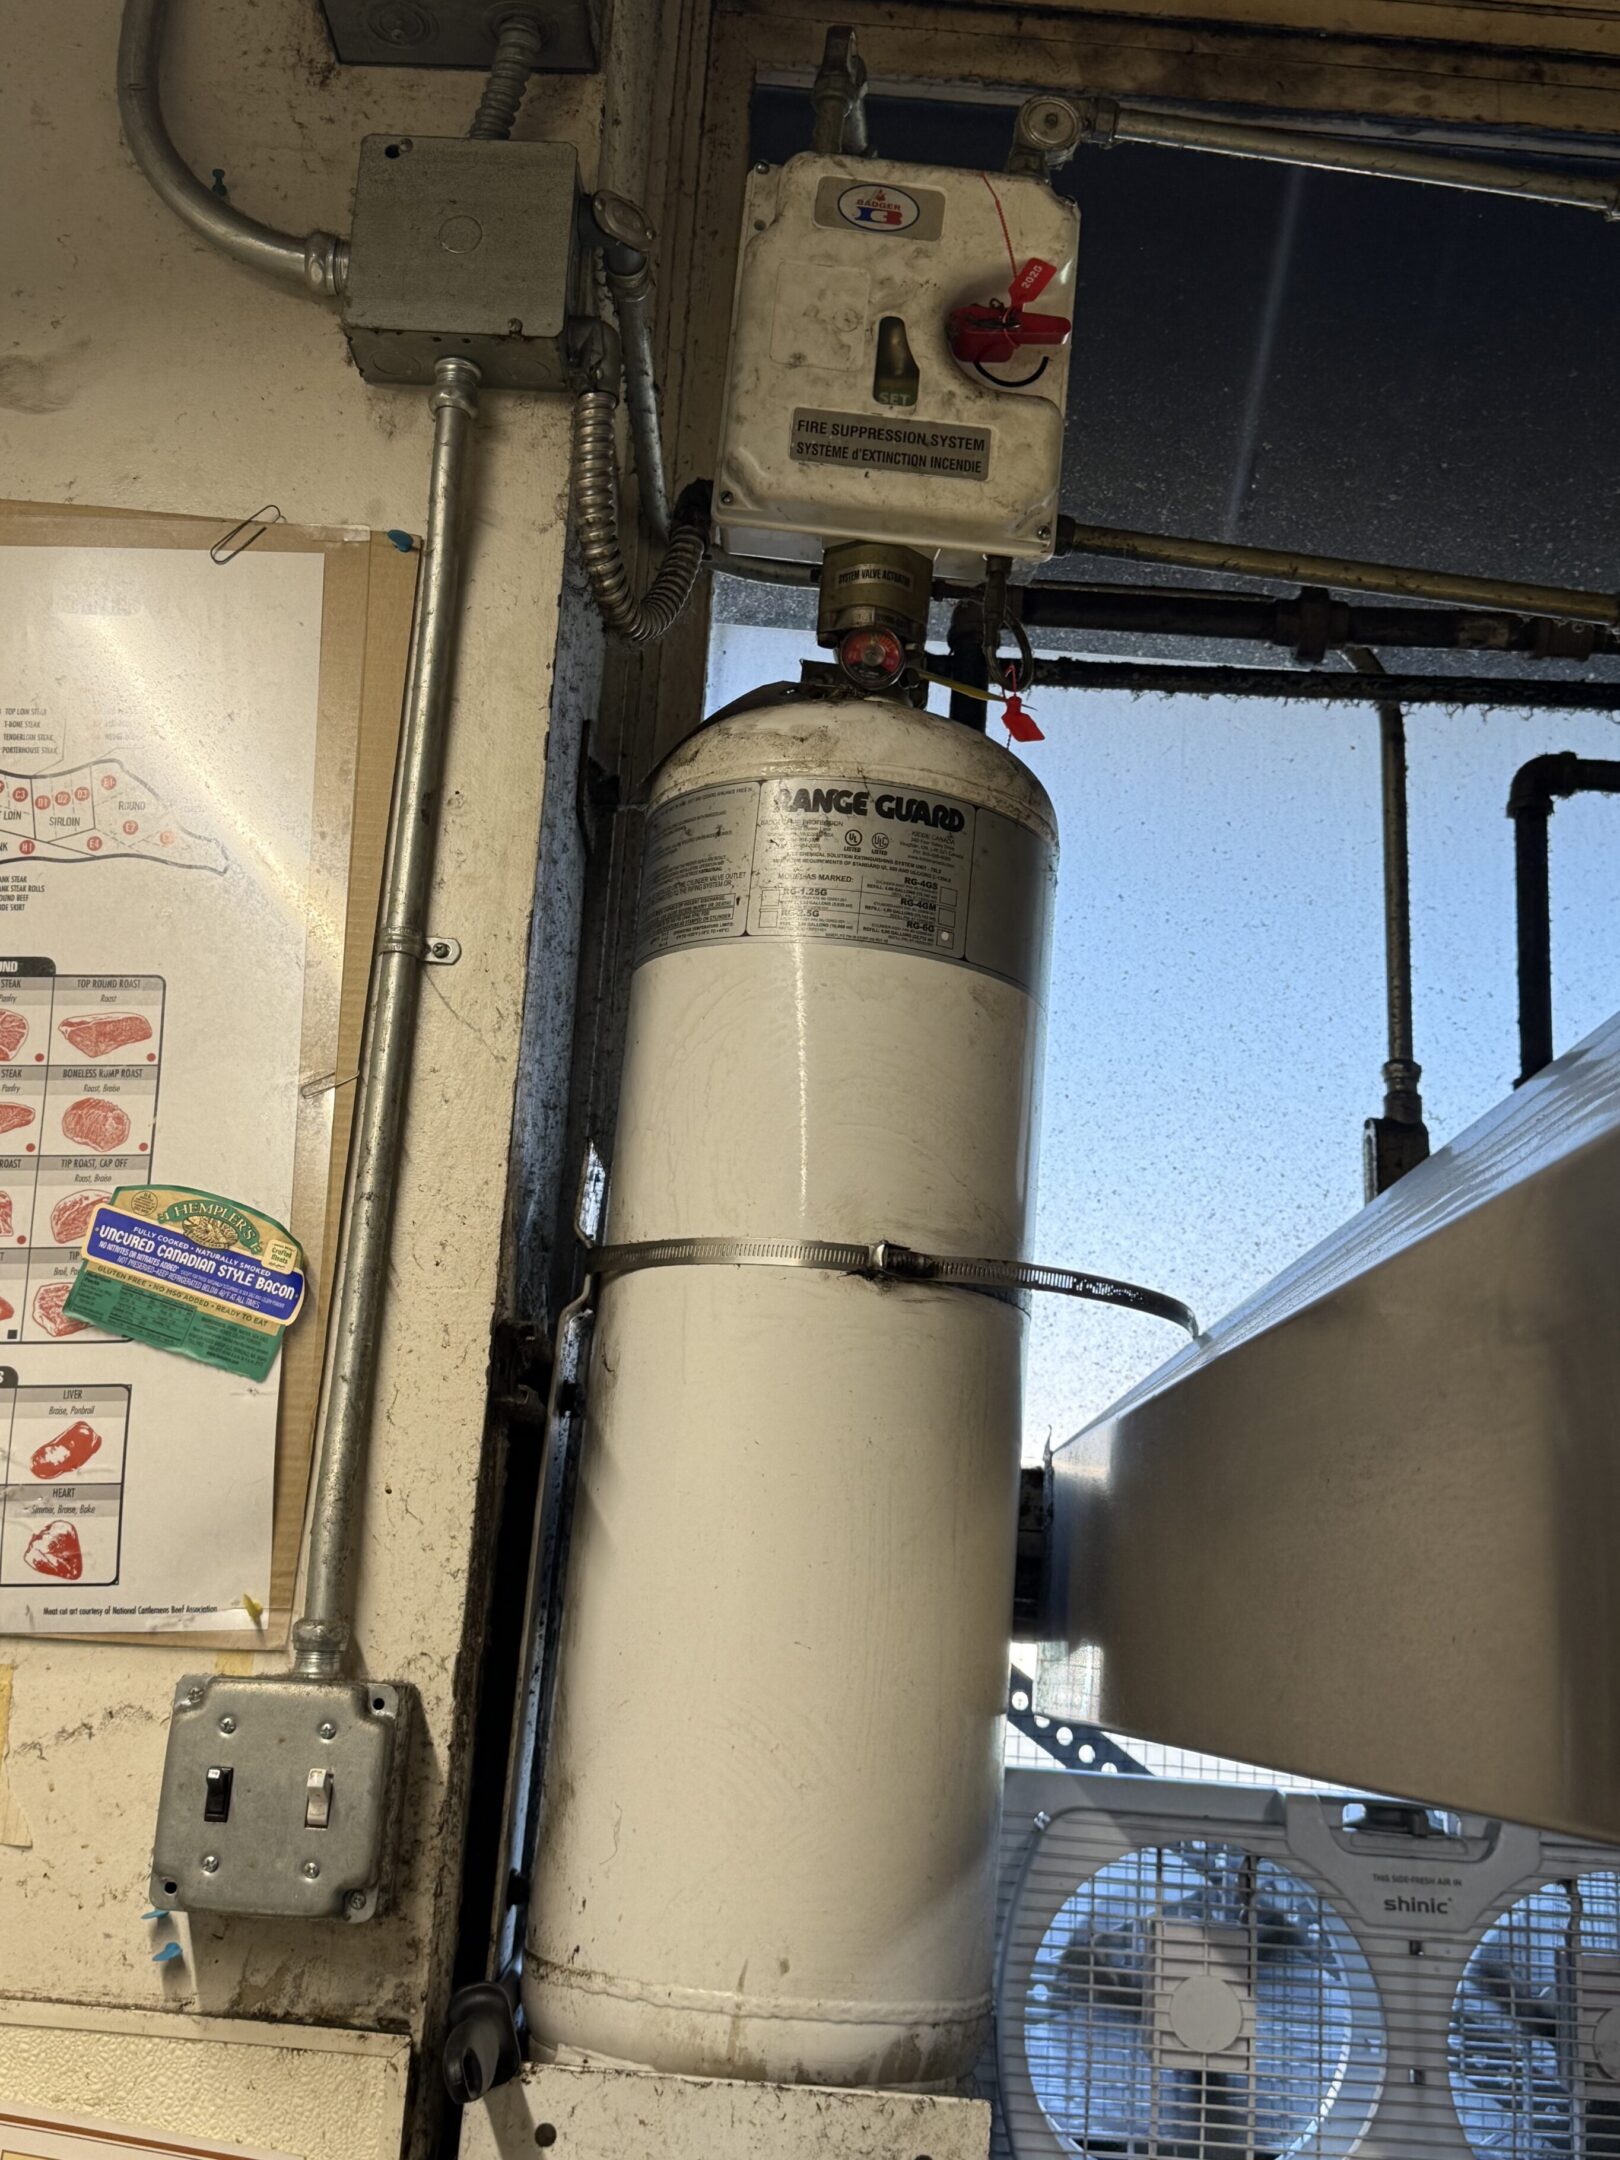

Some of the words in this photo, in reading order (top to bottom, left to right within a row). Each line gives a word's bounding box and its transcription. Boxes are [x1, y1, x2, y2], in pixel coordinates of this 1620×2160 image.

[856, 199, 901, 211] BADGER
[879, 392, 910, 406] SET
[797, 419, 828, 434] FIRE
[831, 423, 926, 445] SUPPRESSION
[930, 434, 985, 451] SYSTEM
[852, 447, 926, 468] d'EXTINCTION
[930, 456, 982, 473] INCENDIE
[861, 568, 881, 579] VALVE
[15, 789, 26, 798] C3
[118, 800, 146, 811] ROUND
[3, 810, 22, 821] LOIN
[874, 794, 965, 833] GUARD
[49, 816, 81, 827] SIRLOIN
[871, 848, 888, 856] LISTED
[11, 875, 28, 883] STEAK
[724, 871, 747, 881] OUTLET
[818, 873, 854, 883] MARKED:
[10, 884, 27, 892] STEAK
[28, 884, 46, 893] ROLLS
[904, 877, 939, 890] RG-4GS
[783, 887, 828, 896] RG-1.25G
[16, 894, 29, 902] BEEF
[900, 897, 937, 912] RG-4GM
[906, 920, 935, 933] RG-6G
[1, 979, 22, 989] STEAK
[77, 979, 91, 988] TOP
[92, 979, 118, 989] ROUND
[119, 979, 141, 989] ROAST
[1, 1068, 22, 1078] STEAK
[62, 1068, 97, 1079] BONELESS
[99, 1068, 120, 1078] RUMP
[121, 1068, 143, 1078] ROAST
[61, 1158, 73, 1169] TIP
[73, 1158, 97, 1170] ROAST,
[99, 1158, 113, 1168] CAP
[114, 1158, 129, 1168] OFF
[174, 1201, 257, 1240] HEMPLER'S
[68, 1250, 80, 1261] TIP
[133, 1226, 157, 1239] FULLY
[157, 1234, 190, 1250] COOKED
[195, 1247, 239, 1266] NATURALLY
[240, 1262, 271, 1277] SMOKED
[99, 1224, 156, 1253] UNCURED
[156, 1244, 217, 1274] CANADIAN
[217, 1264, 255, 1287] STYLE
[255, 1276, 295, 1300] BACON
[97, 1265, 126, 1280] GLUTEN
[127, 1274, 147, 1287] FREE
[153, 1283, 165, 1293] NO
[166, 1287, 182, 1299] MSG
[182, 1293, 210, 1308] ADDED
[215, 1304, 241, 1317] READY
[242, 1312, 252, 1322] TO
[253, 1317, 269, 1327] EAT
[201, 1283, 219, 1295] BELOW
[245, 1298, 261, 1309] TIMES
[63, 1389, 83, 1400] LIVER
[48, 1406, 69, 1416] Braise,
[52, 1487, 76, 1498] HEART
[79, 1504, 96, 1514] Bake
[43, 1607, 57, 1615] Meat
[59, 1607, 68, 1615] cut
[69, 1607, 78, 1615] art
[79, 1607, 103, 1617] courtesy
[104, 1606, 112, 1615] of
[112, 1606, 137, 1615] National
[137, 1605, 170, 1615] Cattlemens
[171, 1605, 185, 1614] Beef
[185, 1605, 218, 1614] Association
[1372, 1873, 1390, 1883] THIS
[1437, 1877, 1452, 1886] AIR
[1453, 1879, 1462, 1887] IN
[1384, 1896, 1448, 1914] shinic
